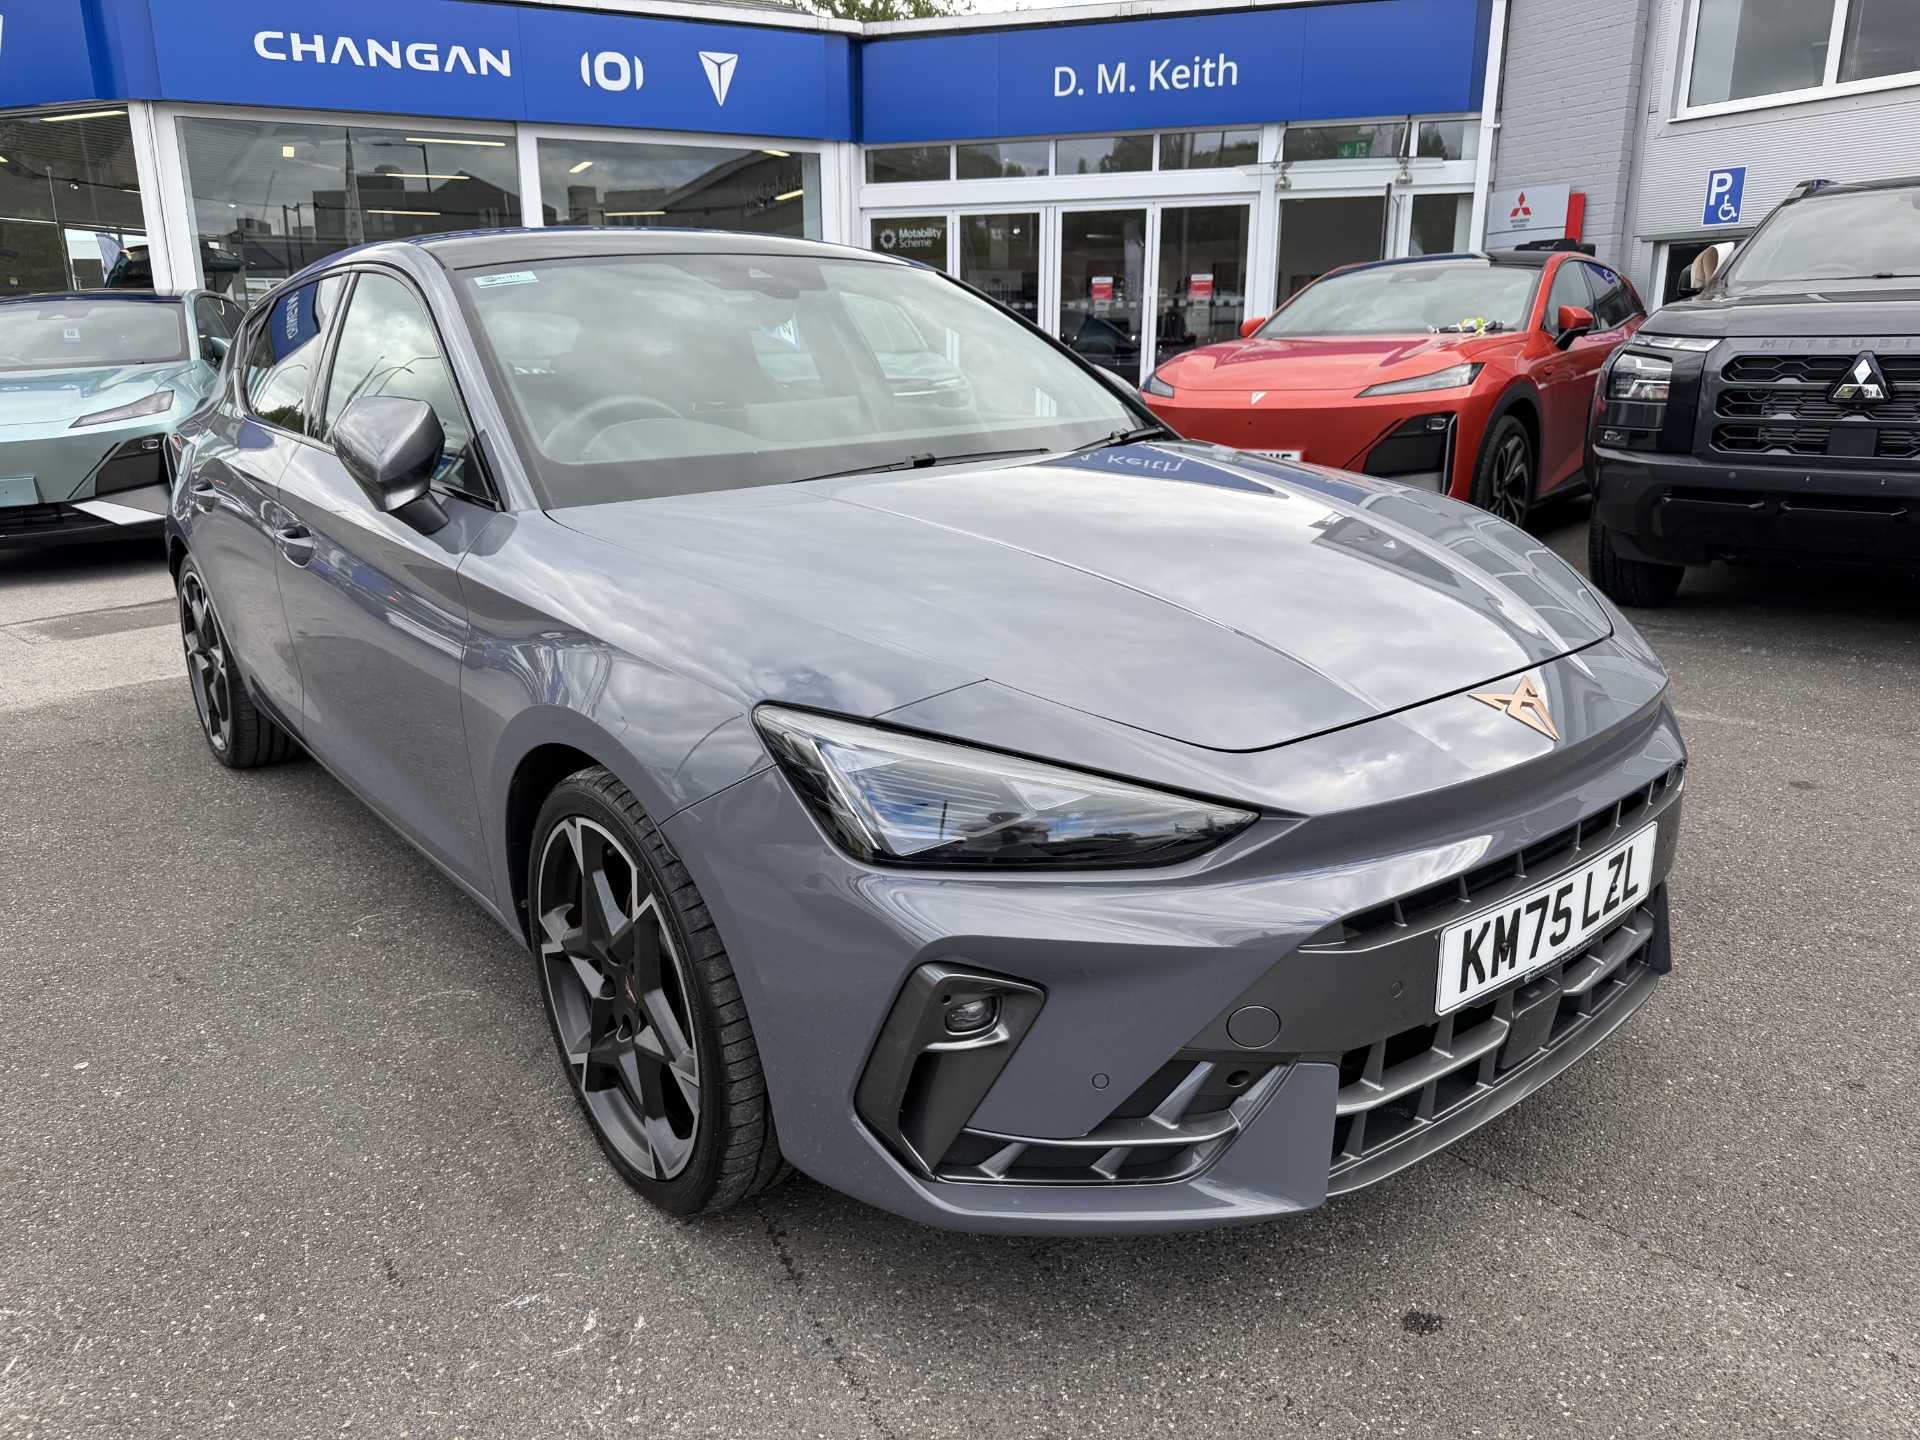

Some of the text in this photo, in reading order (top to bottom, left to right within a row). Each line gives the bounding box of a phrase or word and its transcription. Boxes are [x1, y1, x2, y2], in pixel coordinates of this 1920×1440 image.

[254, 31, 511, 77] CHANGAN
[1054, 53, 1238, 97] D. M. Keith
[1709, 172, 1733, 206] P
[898, 227, 942, 240] Motability
[1459, 882, 1573, 994] KM75
[1581, 846, 1639, 930] LZL
